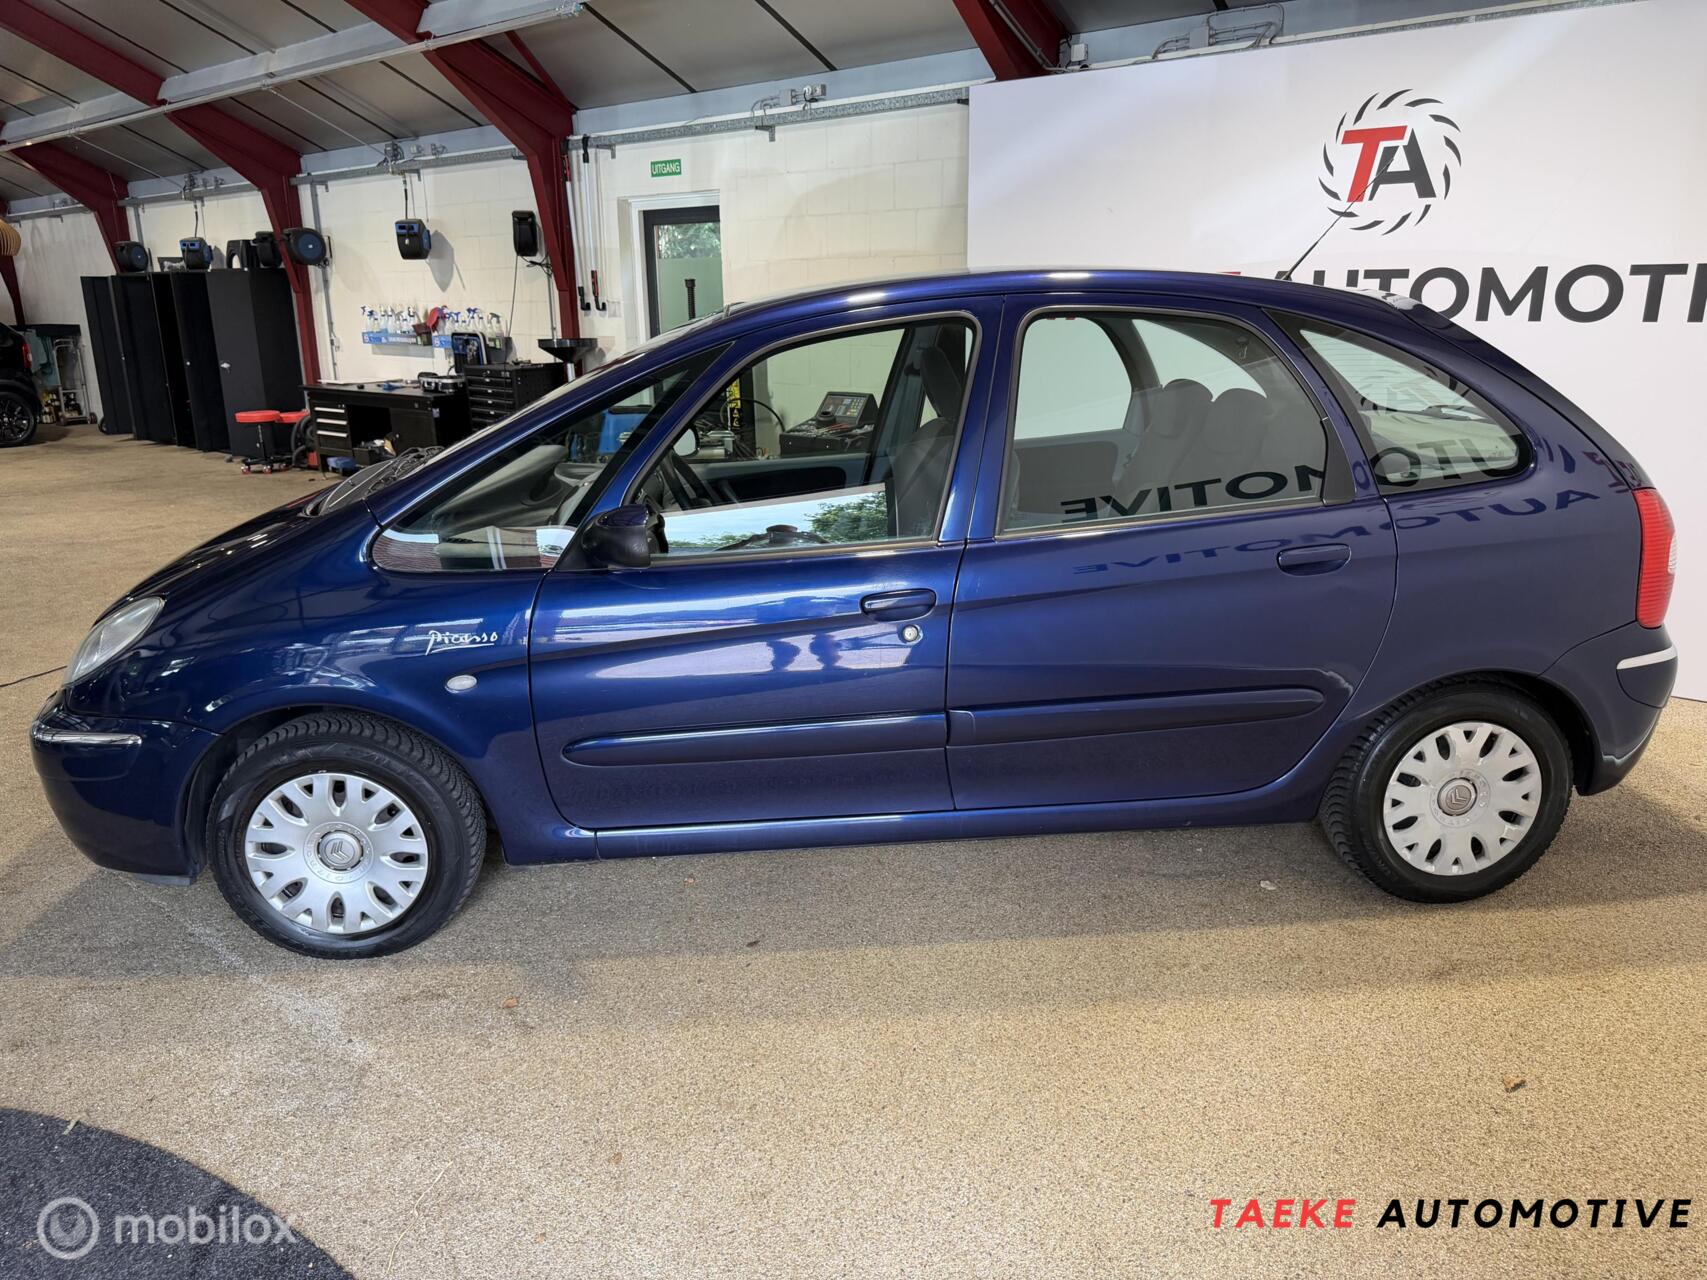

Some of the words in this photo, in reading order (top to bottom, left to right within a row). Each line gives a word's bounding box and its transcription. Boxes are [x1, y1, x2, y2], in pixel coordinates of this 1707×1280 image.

[651, 161, 681, 175] UITGANG
[1341, 125, 1437, 203] TA
[1275, 262, 1707, 324] TOMOTI
